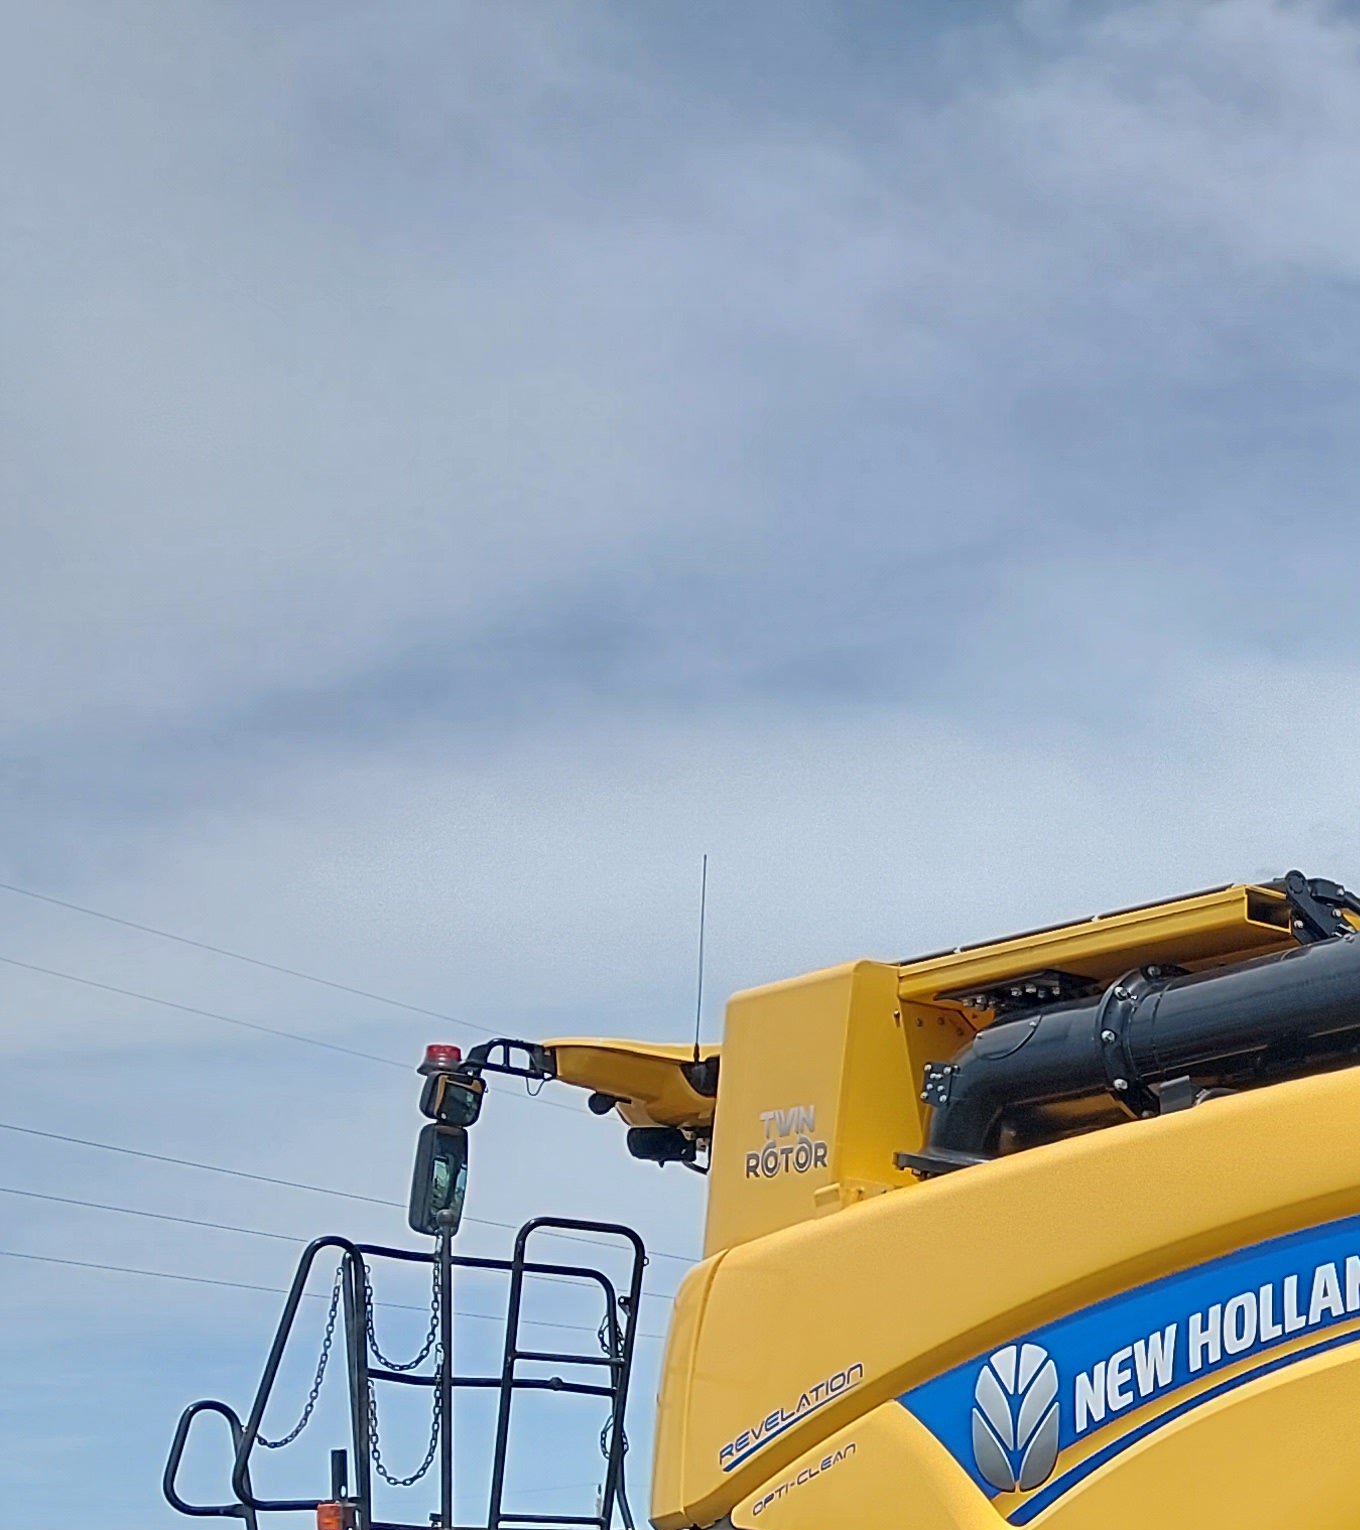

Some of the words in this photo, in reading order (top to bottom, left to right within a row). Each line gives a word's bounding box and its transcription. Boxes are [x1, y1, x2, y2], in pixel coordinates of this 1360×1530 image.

[745, 1134, 828, 1179] ROTOR
[760, 1104, 815, 1139] TWIN
[719, 1363, 864, 1466] REVELATION
[1075, 1322, 1178, 1434] NEW
[752, 1443, 857, 1516] OPTI-CLEAN
